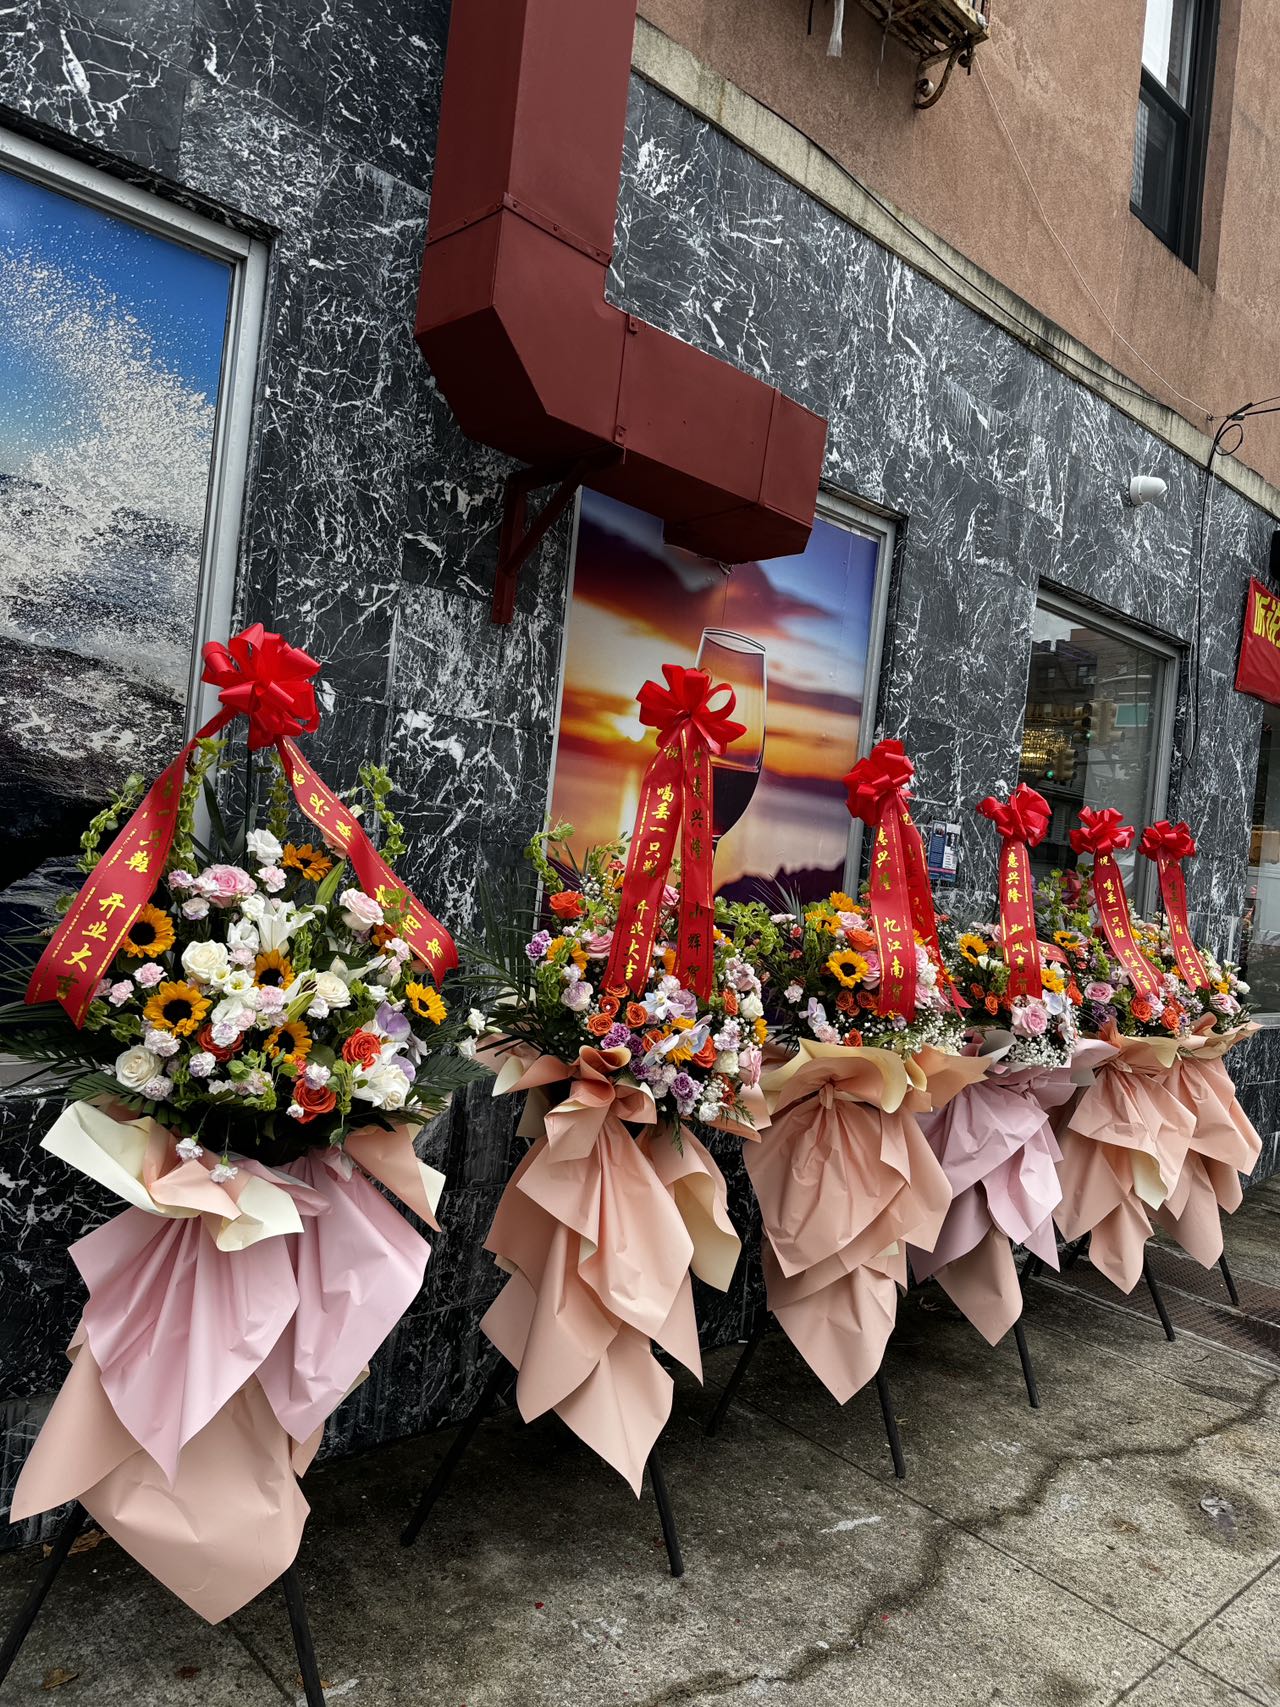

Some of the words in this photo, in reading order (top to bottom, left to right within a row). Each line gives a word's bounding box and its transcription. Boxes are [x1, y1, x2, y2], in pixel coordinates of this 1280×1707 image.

[642, 783, 674, 878] 喝丢一只鞋
[1006, 846, 1024, 903] 意兴隆
[56, 892, 126, 1001] 开业大吉
[624, 900, 650, 980] 开业大吉
[883, 917, 905, 1003] 忆江南贺
[1102, 878, 1127, 939] 喝丢一只鞋
[1123, 948, 1151, 990] 开业大吉
[1180, 945, 1202, 986] 开业大吉
